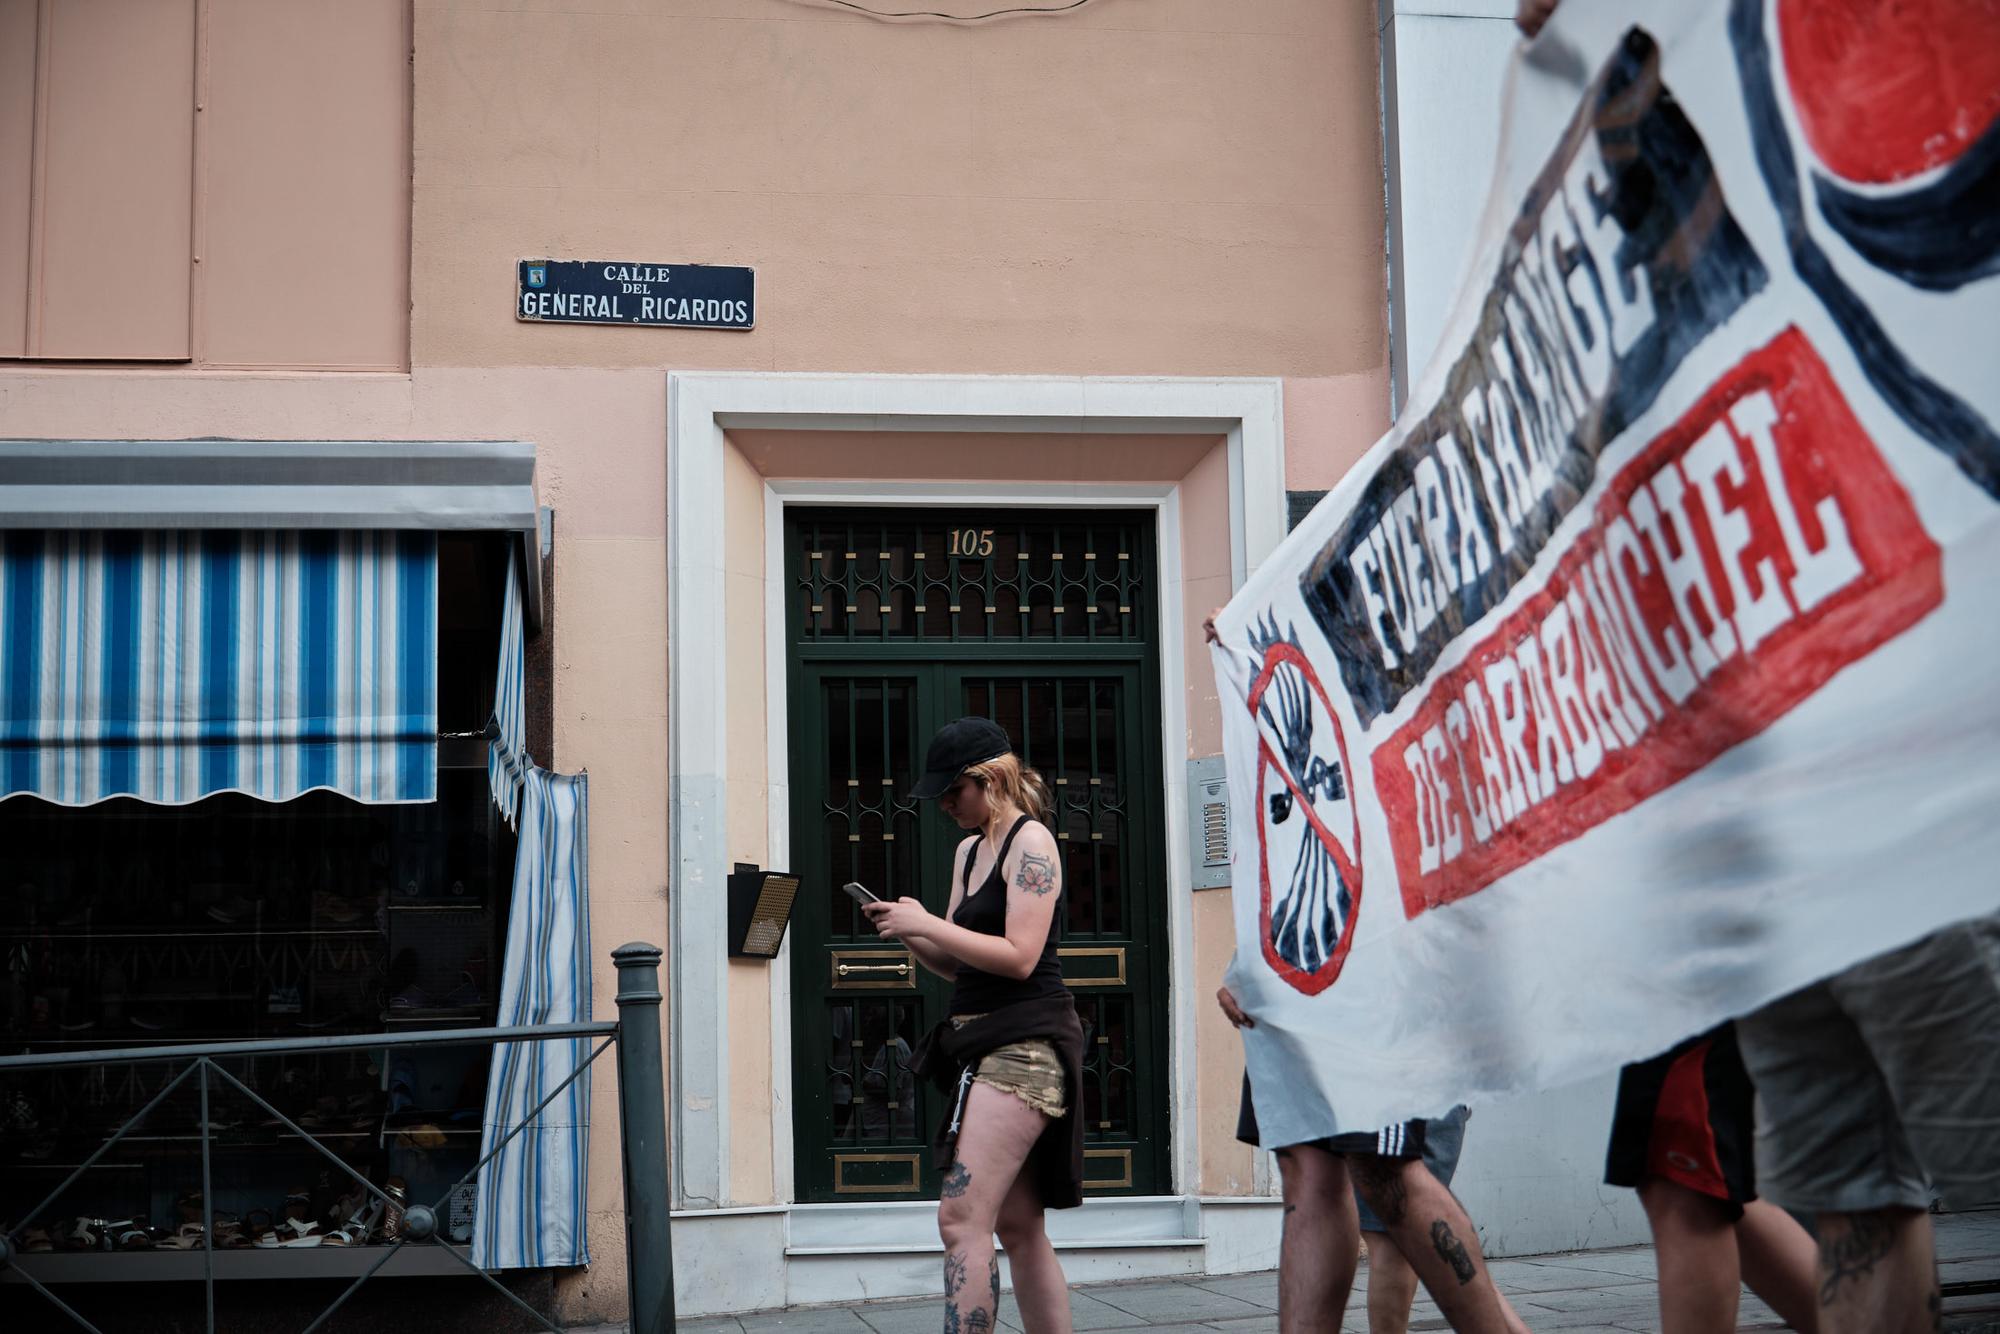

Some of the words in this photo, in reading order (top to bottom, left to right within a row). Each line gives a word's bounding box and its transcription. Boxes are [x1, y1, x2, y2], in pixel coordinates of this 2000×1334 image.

[603, 265, 670, 283] CALLE
[622, 283, 651, 295] DEL
[523, 292, 623, 318] GENERAL
[641, 297, 748, 323] RICARDOS
[1350, 432, 1492, 670] FUERA
[1462, 128, 1658, 554] FALANGE
[949, 529, 994, 556] 105
[1403, 741, 1463, 877] DE
[1446, 390, 1864, 843] CARABANCHEL
